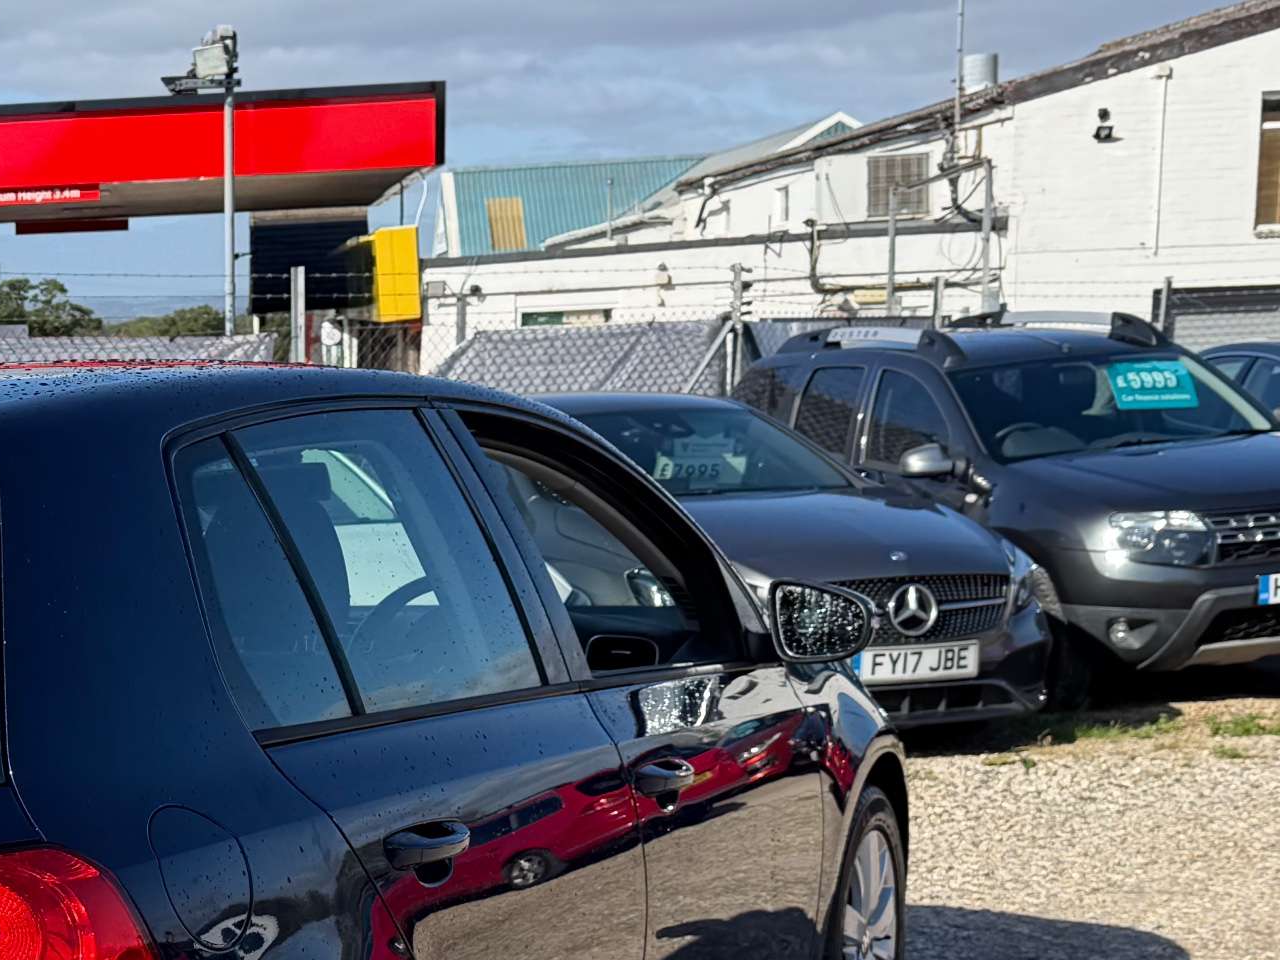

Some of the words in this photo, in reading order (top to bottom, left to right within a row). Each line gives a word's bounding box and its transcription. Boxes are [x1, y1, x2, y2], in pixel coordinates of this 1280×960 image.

[18, 190, 52, 202] Height
[53, 189, 80, 199] 3.4m
[1116, 370, 1178, 389] £5995
[870, 651, 924, 676] FY17
[928, 646, 969, 672] JBE
